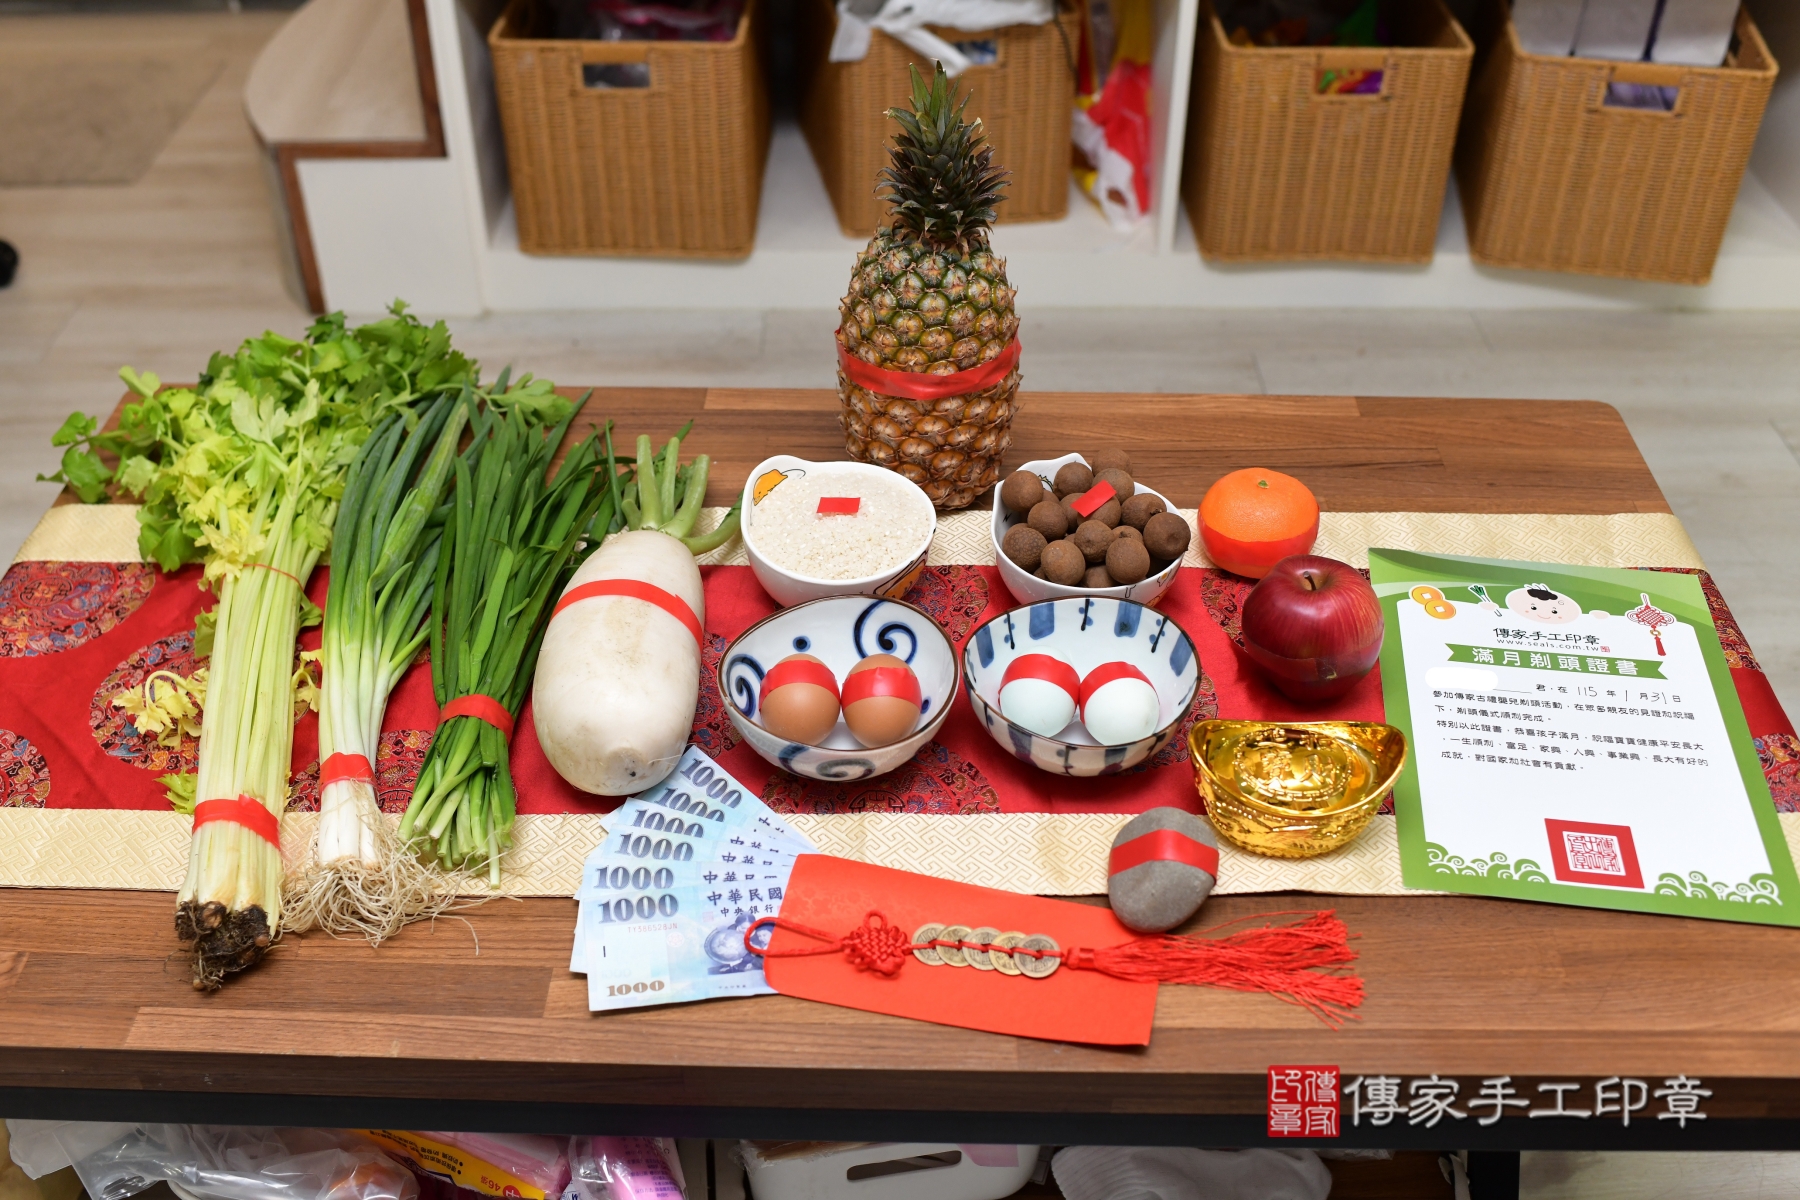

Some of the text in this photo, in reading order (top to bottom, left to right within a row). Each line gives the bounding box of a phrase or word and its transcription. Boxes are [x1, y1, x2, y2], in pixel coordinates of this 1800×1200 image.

[1493, 628, 1599, 645] 傳家手工印章
[1497, 639, 1599, 651] www.seals.com.tw
[1472, 648, 1638, 675] 滿月剃頭證書
[1578, 686, 1597, 697] 115
[1606, 690, 1616, 698] 年
[1640, 692, 1649, 700] 月
[1651, 692, 1667, 704] 31
[1672, 695, 1682, 703] 日
[680, 758, 742, 809] 1000
[614, 832, 694, 861] 1000
[593, 865, 674, 890] 1000
[707, 887, 782, 906] 中華民國
[598, 893, 679, 924] 1000
[720, 904, 773, 917] 中央銀行
[606, 980, 665, 997] 1000
